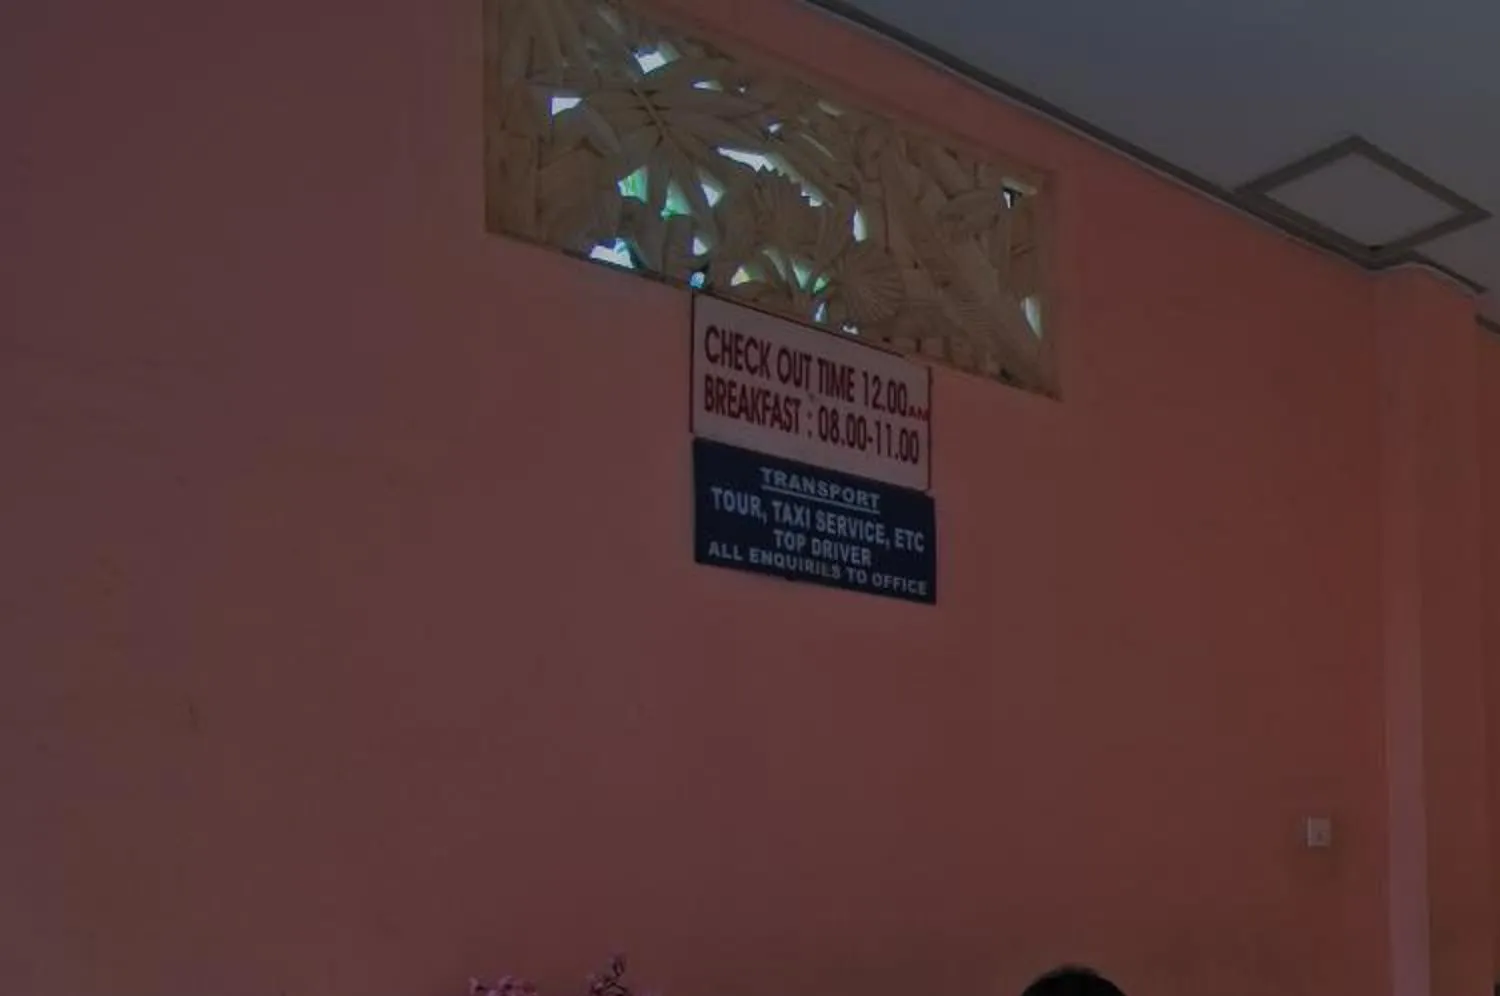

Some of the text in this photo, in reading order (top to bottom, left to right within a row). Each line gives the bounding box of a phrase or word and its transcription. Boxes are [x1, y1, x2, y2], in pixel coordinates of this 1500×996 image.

[705, 325, 771, 380] CHECK
[777, 347, 812, 391] OUT
[818, 358, 855, 402] TIME
[705, 374, 801, 434] BREAKFAST
[759, 466, 880, 509] TRANSPORT
[711, 486, 926, 553] TOUR, TAXI SERVICE, ETC
[708, 541, 744, 561] ALL
[846, 566, 868, 584] TO
[872, 572, 929, 596] OFFICE
[773, 529, 872, 568] TOP DRIVER
